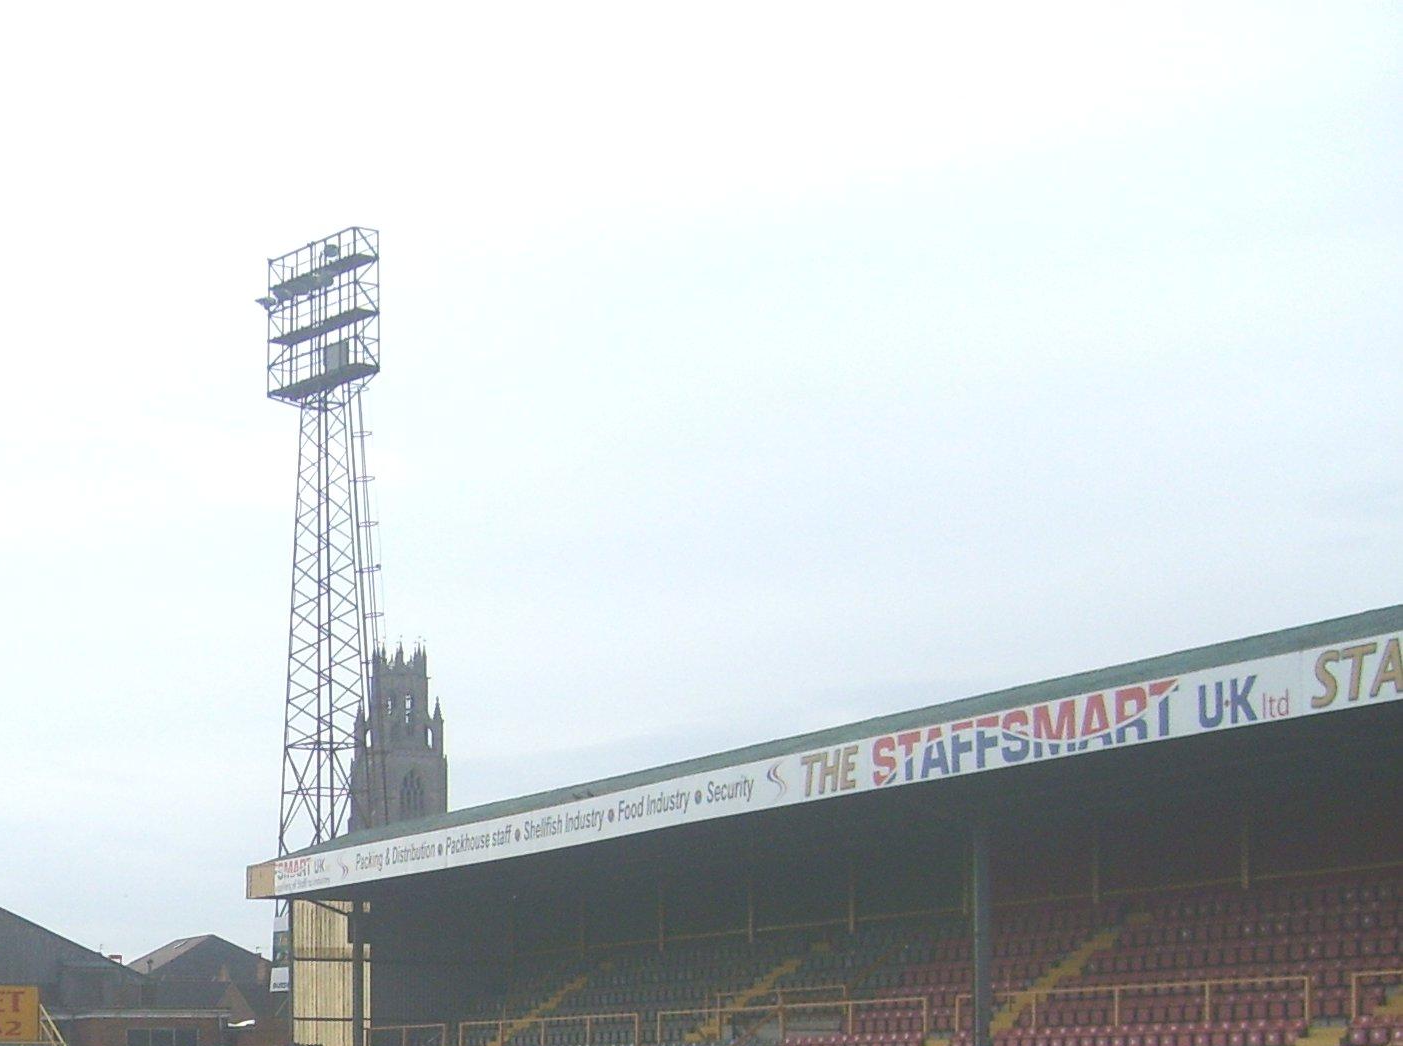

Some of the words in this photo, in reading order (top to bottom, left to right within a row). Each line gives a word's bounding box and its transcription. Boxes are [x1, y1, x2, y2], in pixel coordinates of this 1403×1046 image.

[800, 744, 859, 797] THE
[872, 677, 1180, 787] STAFFSMART
[1262, 688, 1290, 719] ltd
[314, 855, 326, 875] UK
[355, 847, 384, 872] Packing
[385, 842, 391, 865] &
[392, 836, 436, 864] Distribution
[445, 829, 490, 857] Packhouse
[492, 823, 511, 849] staff
[523, 815, 563, 842] Shellfish
[565, 806, 605, 834] Industry
[617, 797, 644, 823] Food
[646, 787, 690, 816] Industry
[707, 775, 754, 804] Security
